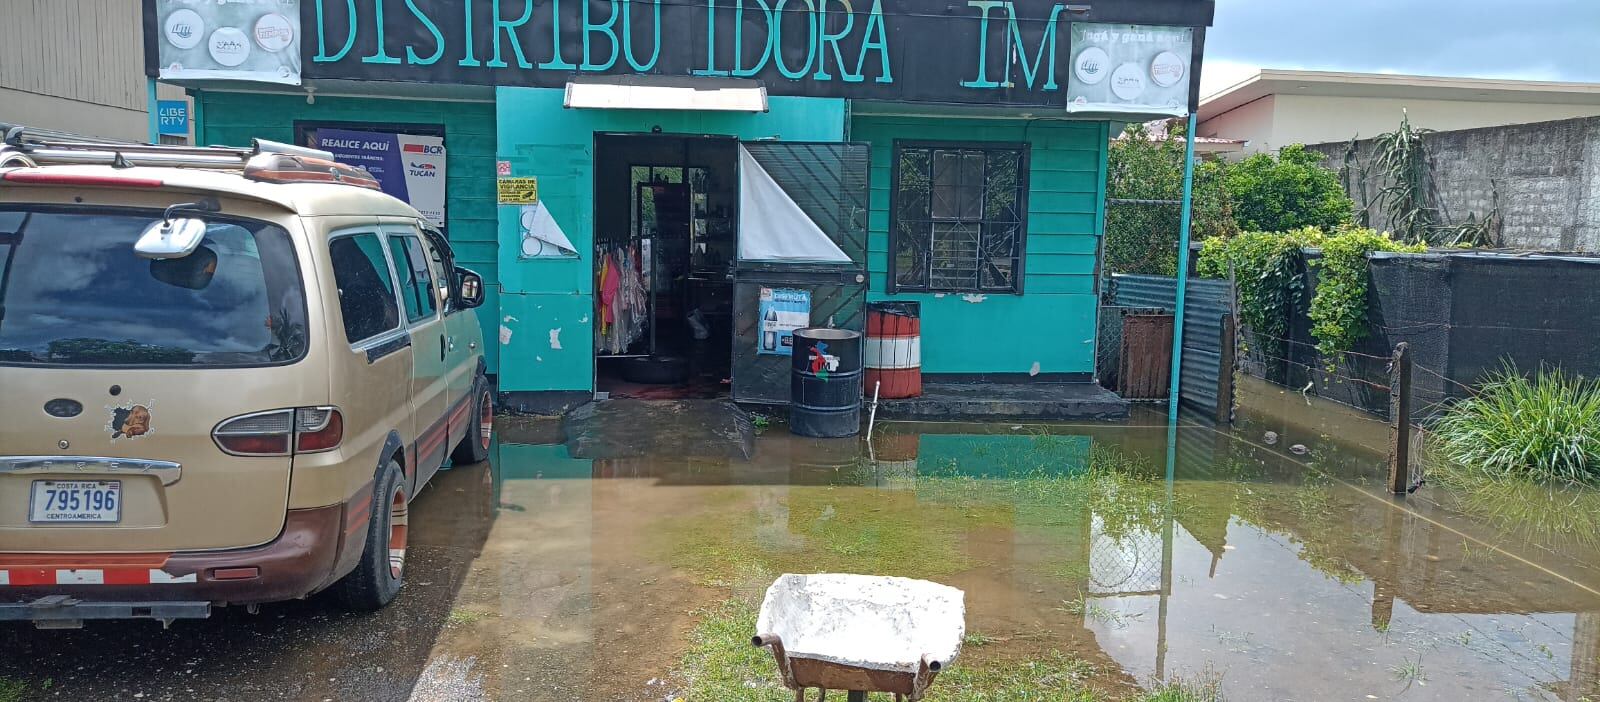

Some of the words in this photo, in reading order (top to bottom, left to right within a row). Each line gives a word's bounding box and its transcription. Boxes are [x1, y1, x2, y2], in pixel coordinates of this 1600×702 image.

[960, 0, 1064, 90] IM
[321, 138, 361, 150] REALICE
[362, 141, 390, 152] AQUÍ
[424, 144, 444, 155] BCR
[408, 169, 436, 178] TUCAN
[45, 489, 116, 511] 795196
